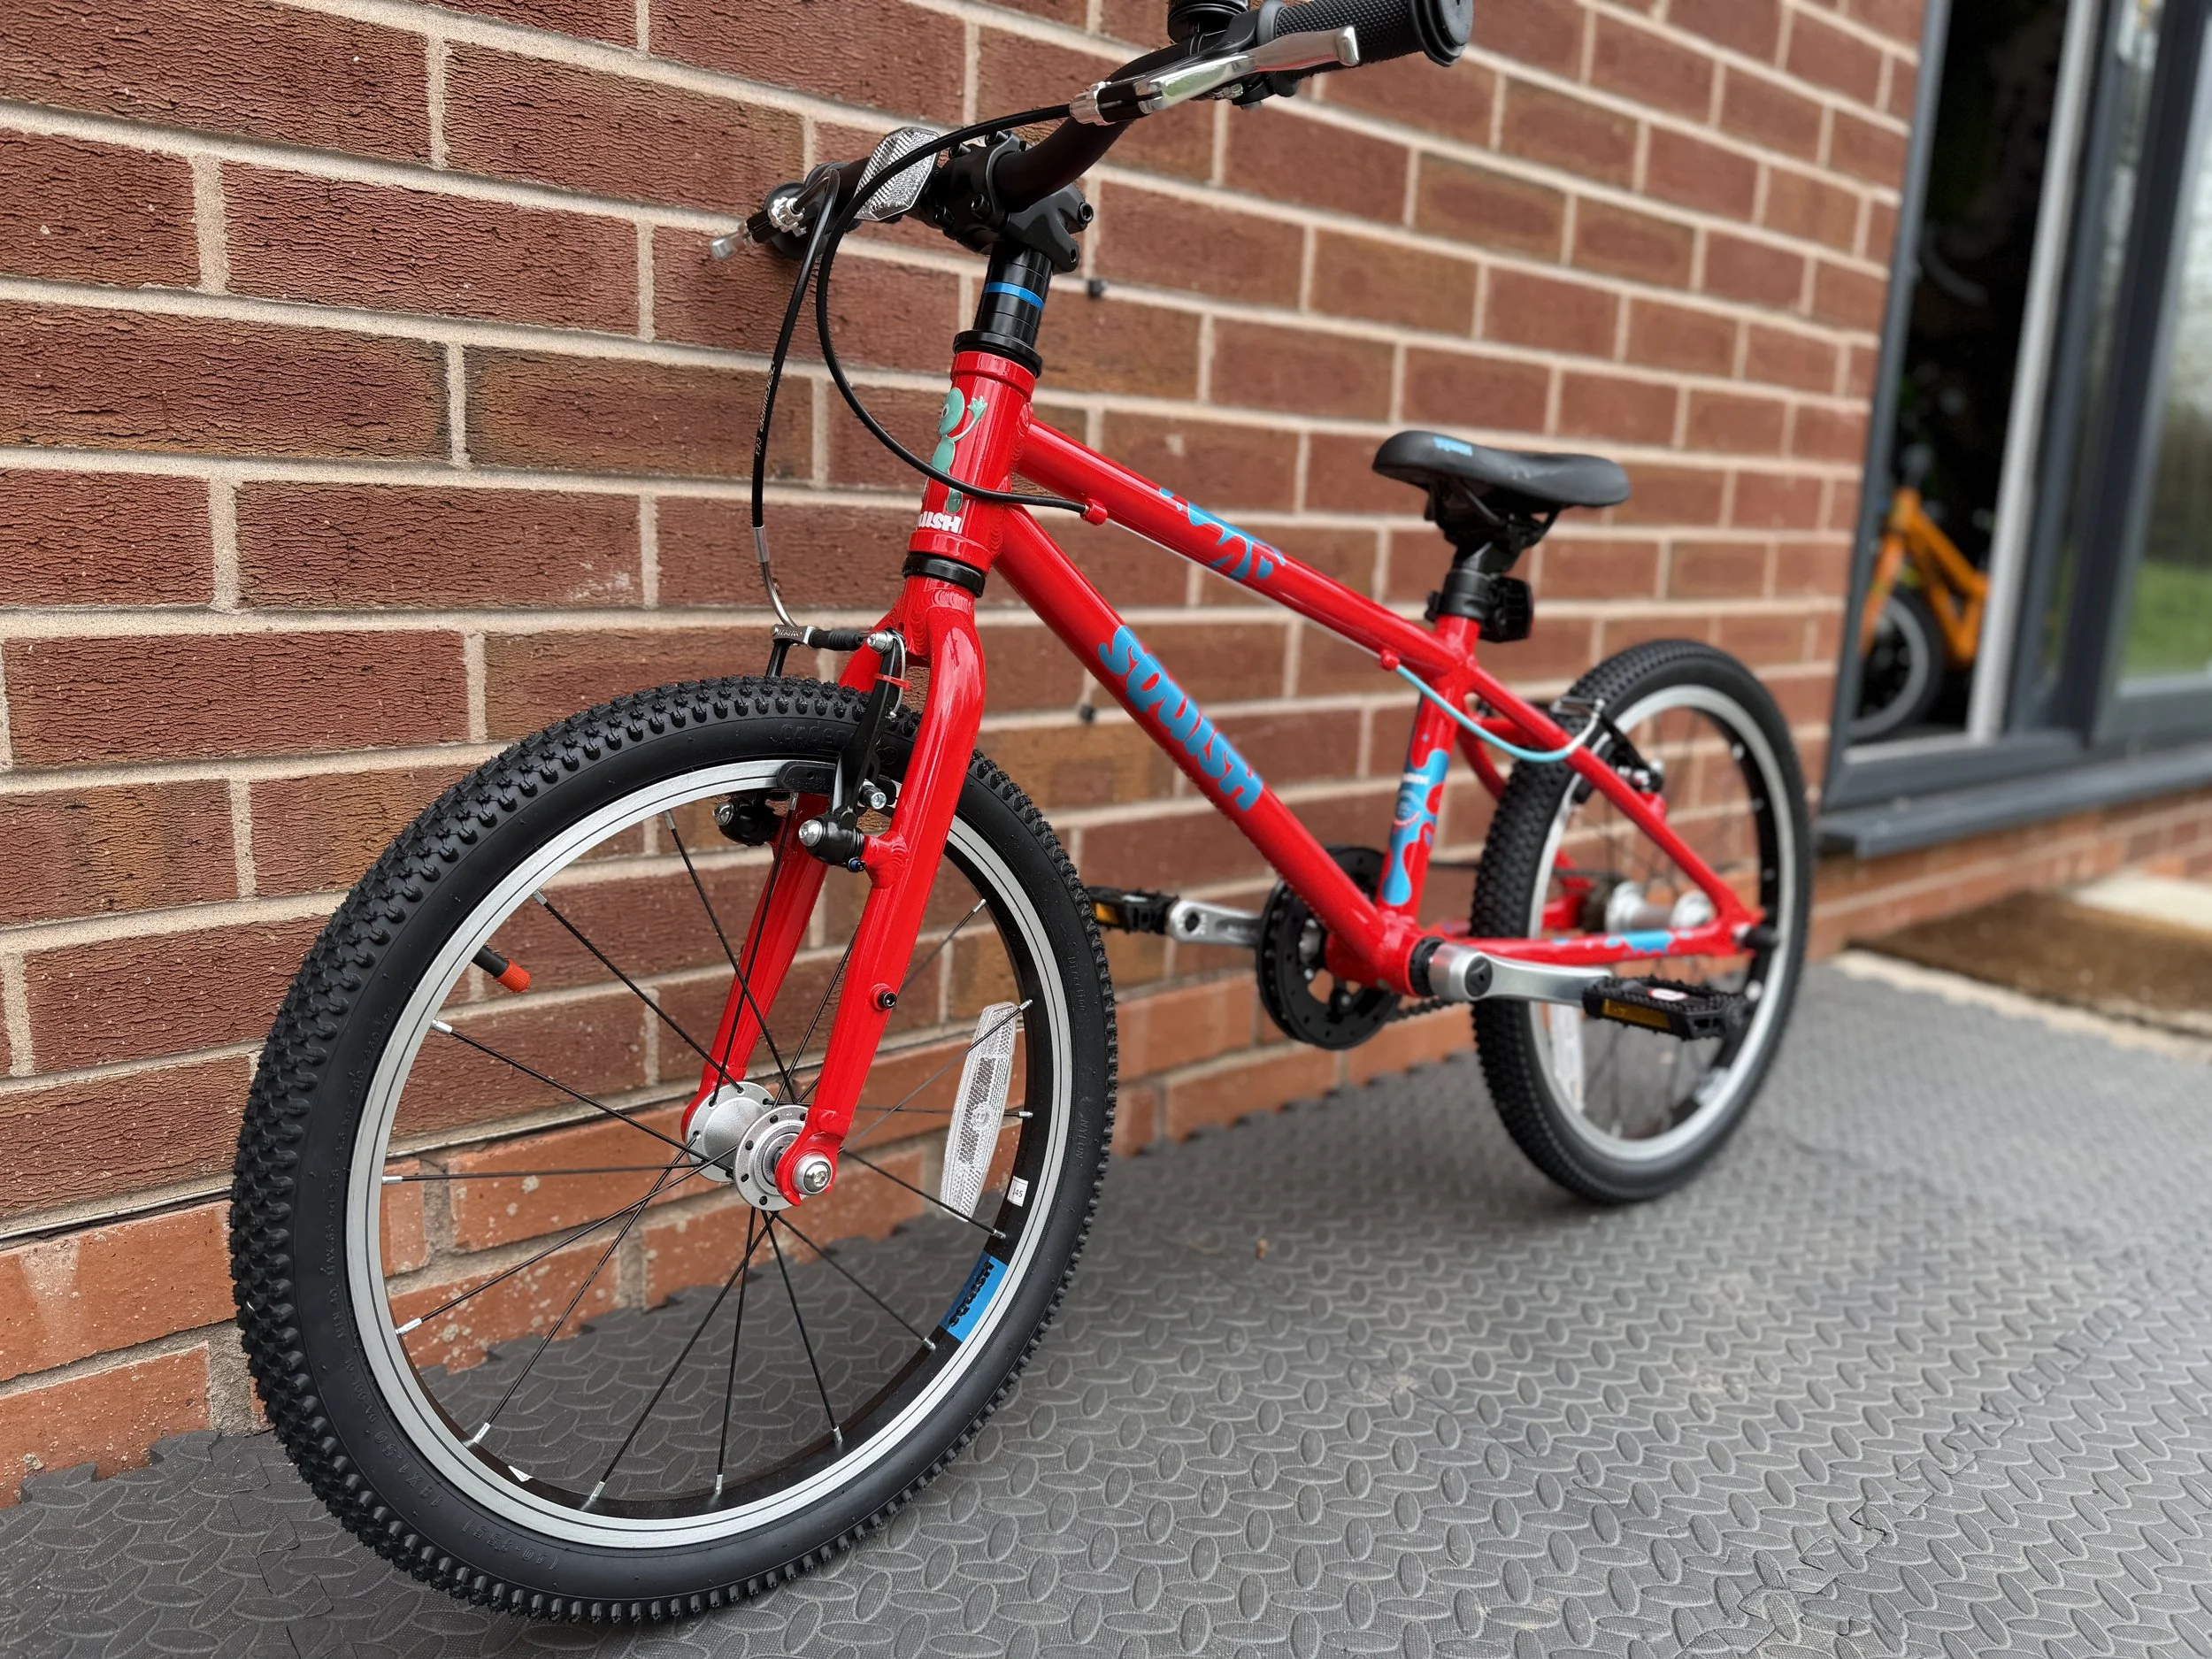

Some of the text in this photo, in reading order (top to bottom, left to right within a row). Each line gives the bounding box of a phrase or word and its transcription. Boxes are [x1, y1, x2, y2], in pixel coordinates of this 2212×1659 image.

[1098, 625, 1263, 811] SQUISH
[1075, 1118, 1089, 1159] NYLON
[949, 1261, 995, 1327] SQUISH
